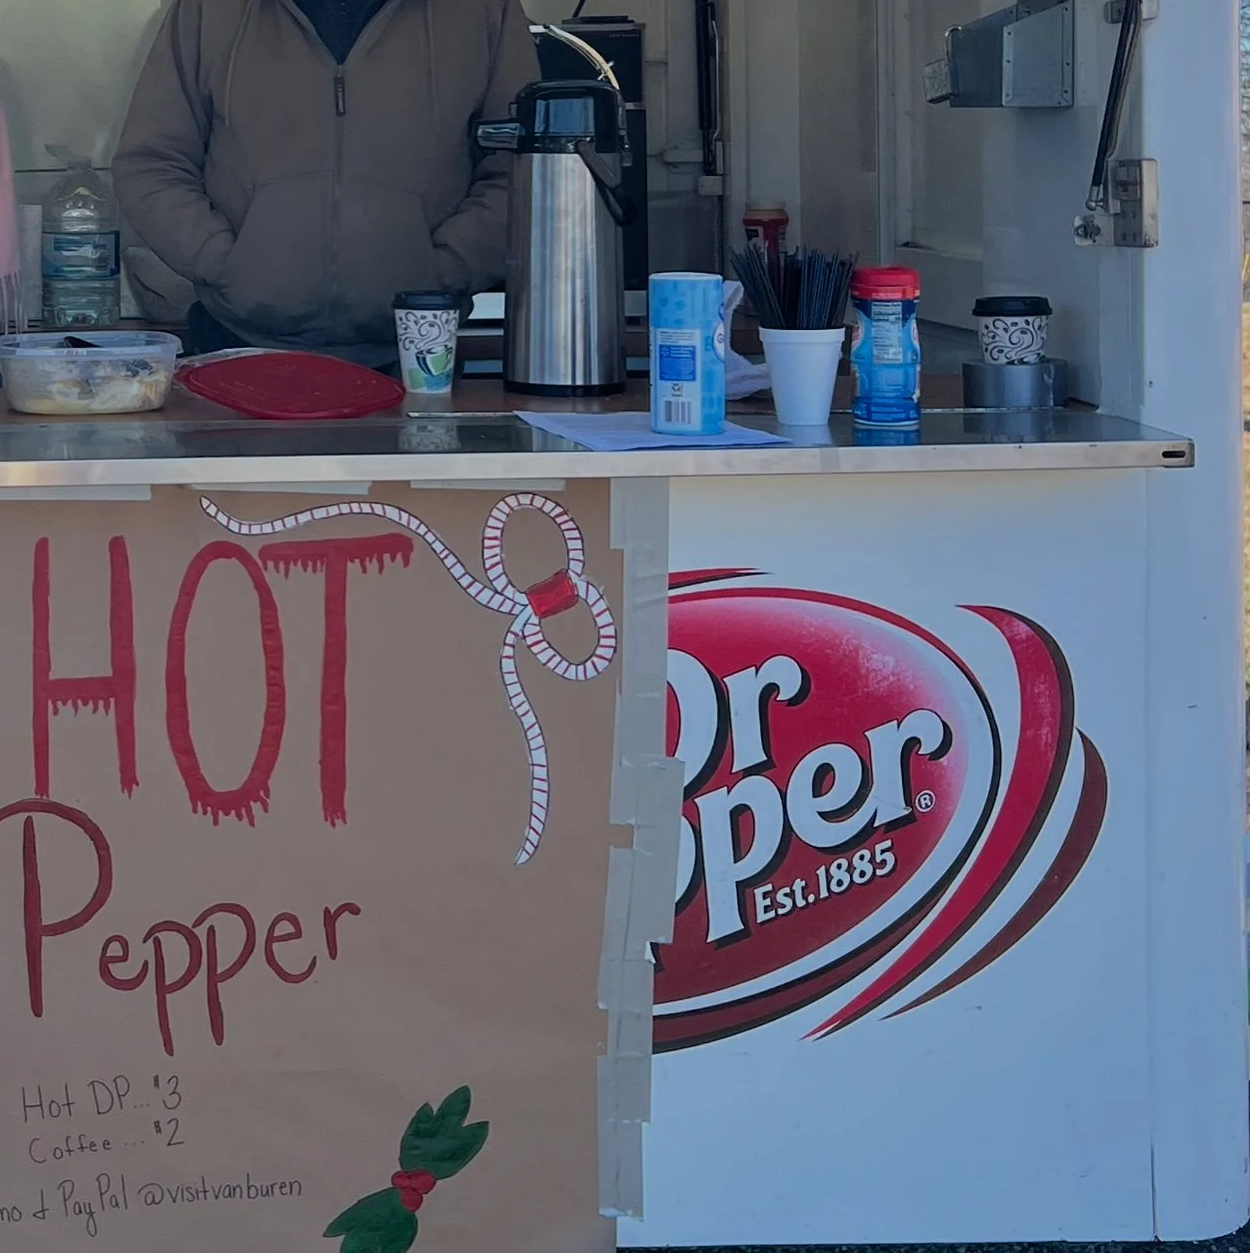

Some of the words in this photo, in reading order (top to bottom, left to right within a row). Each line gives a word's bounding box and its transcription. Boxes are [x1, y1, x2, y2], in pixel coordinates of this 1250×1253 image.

[32, 532, 415, 828] HOT
[21, 1082, 76, 1124] Hot
[28, 1134, 113, 1164] Coffee
[56, 1173, 129, 1238] PayPal
[137, 1172, 303, 1207] @visitvanburen
